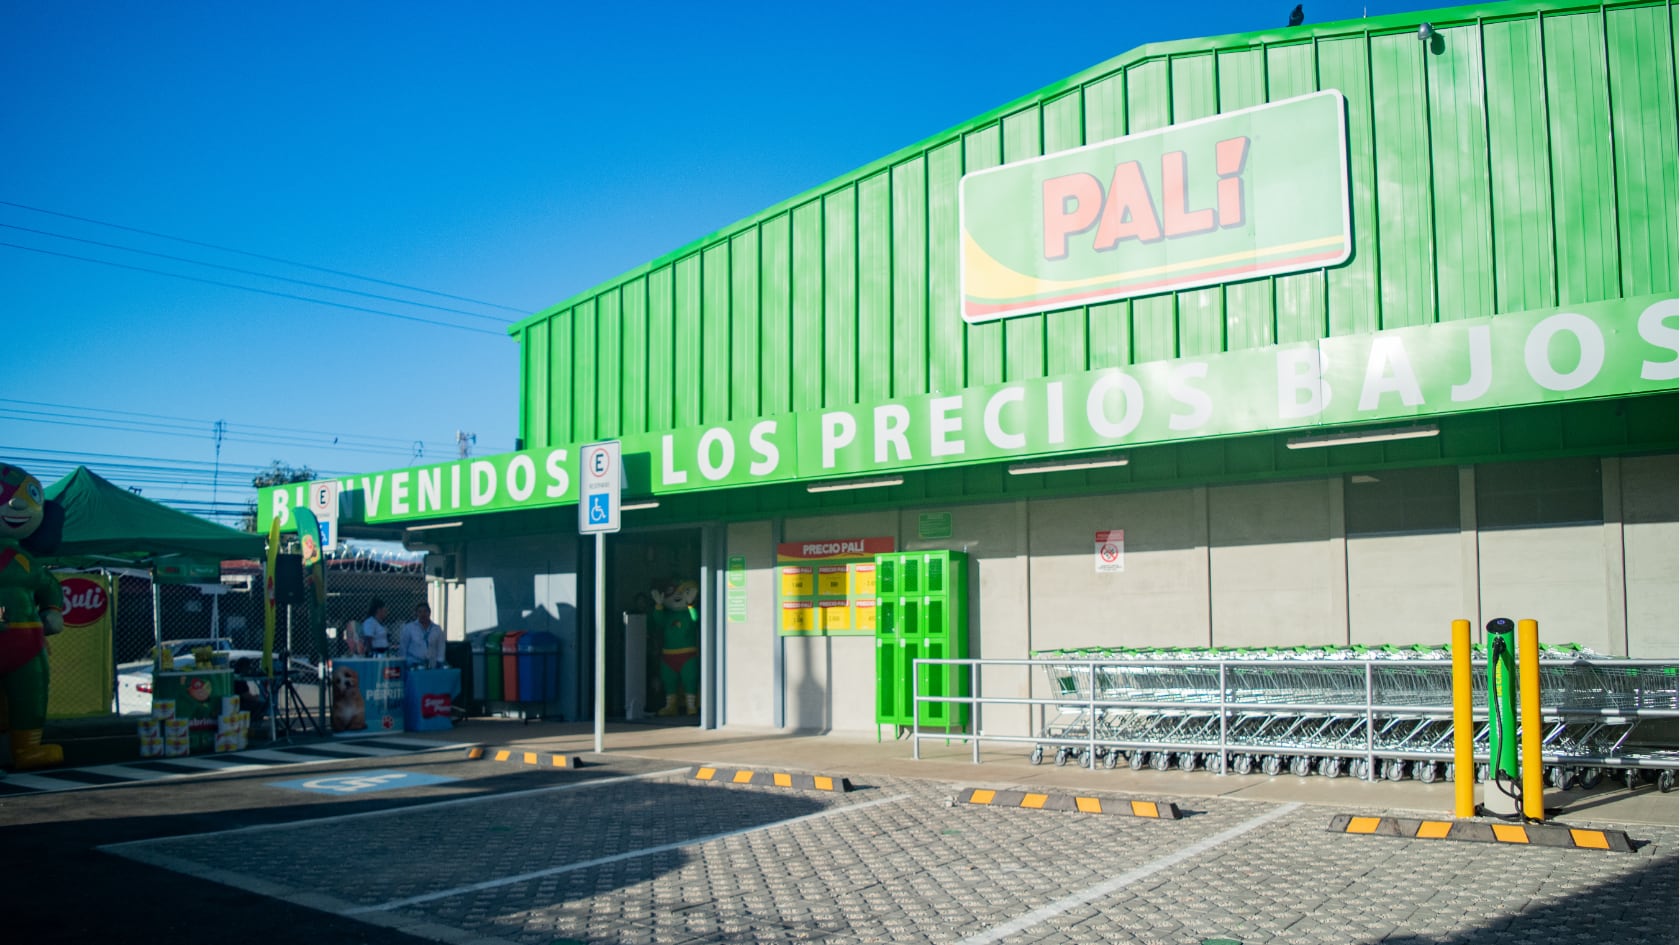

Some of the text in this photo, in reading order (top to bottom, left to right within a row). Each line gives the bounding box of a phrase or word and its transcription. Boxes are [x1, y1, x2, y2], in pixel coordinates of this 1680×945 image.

[1042, 136, 1250, 260] PALÍ
[272, 298, 1679, 527] BINVENIDOS LOS PRECIOS BAJOS
[596, 454, 604, 472] E
[320, 490, 326, 505] E
[803, 539, 865, 555] PRECIO PALÍ
[61, 586, 103, 615] Suli
